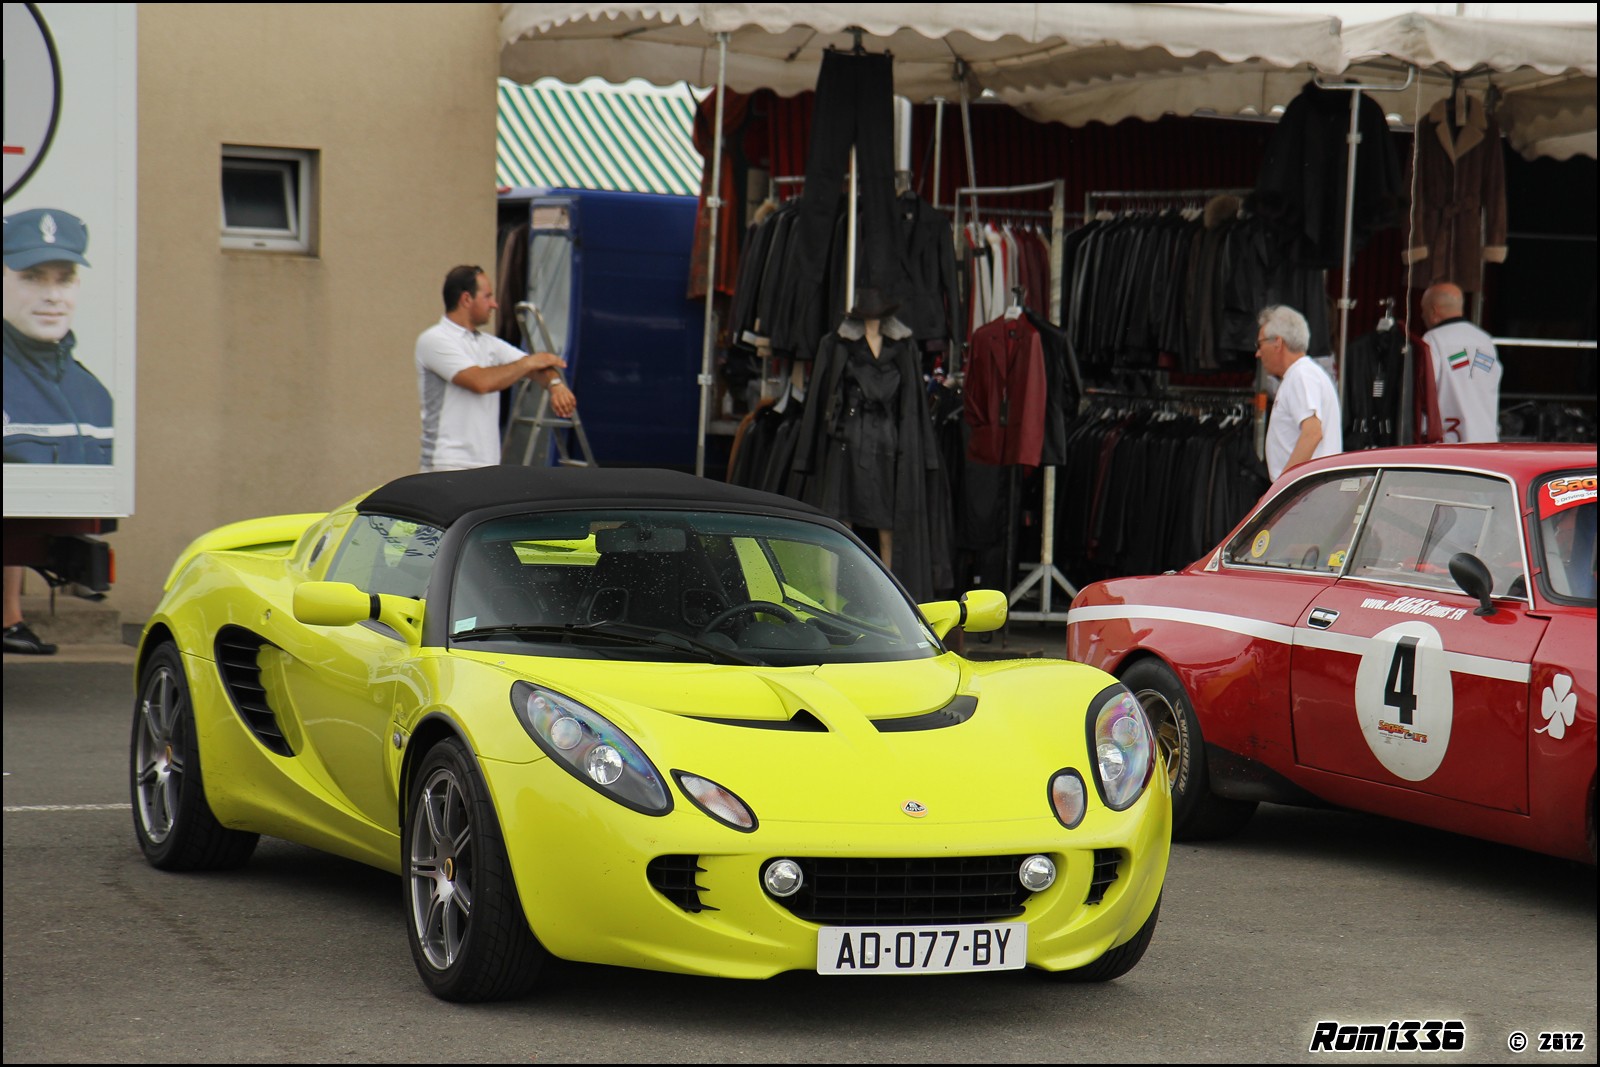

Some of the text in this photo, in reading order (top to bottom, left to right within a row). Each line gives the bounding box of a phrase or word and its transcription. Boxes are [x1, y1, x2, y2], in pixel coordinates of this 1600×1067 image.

[1384, 635, 1420, 725] 4
[1179, 719, 1190, 792] MICHELIN
[836, 928, 1011, 969] AD-077-BY
